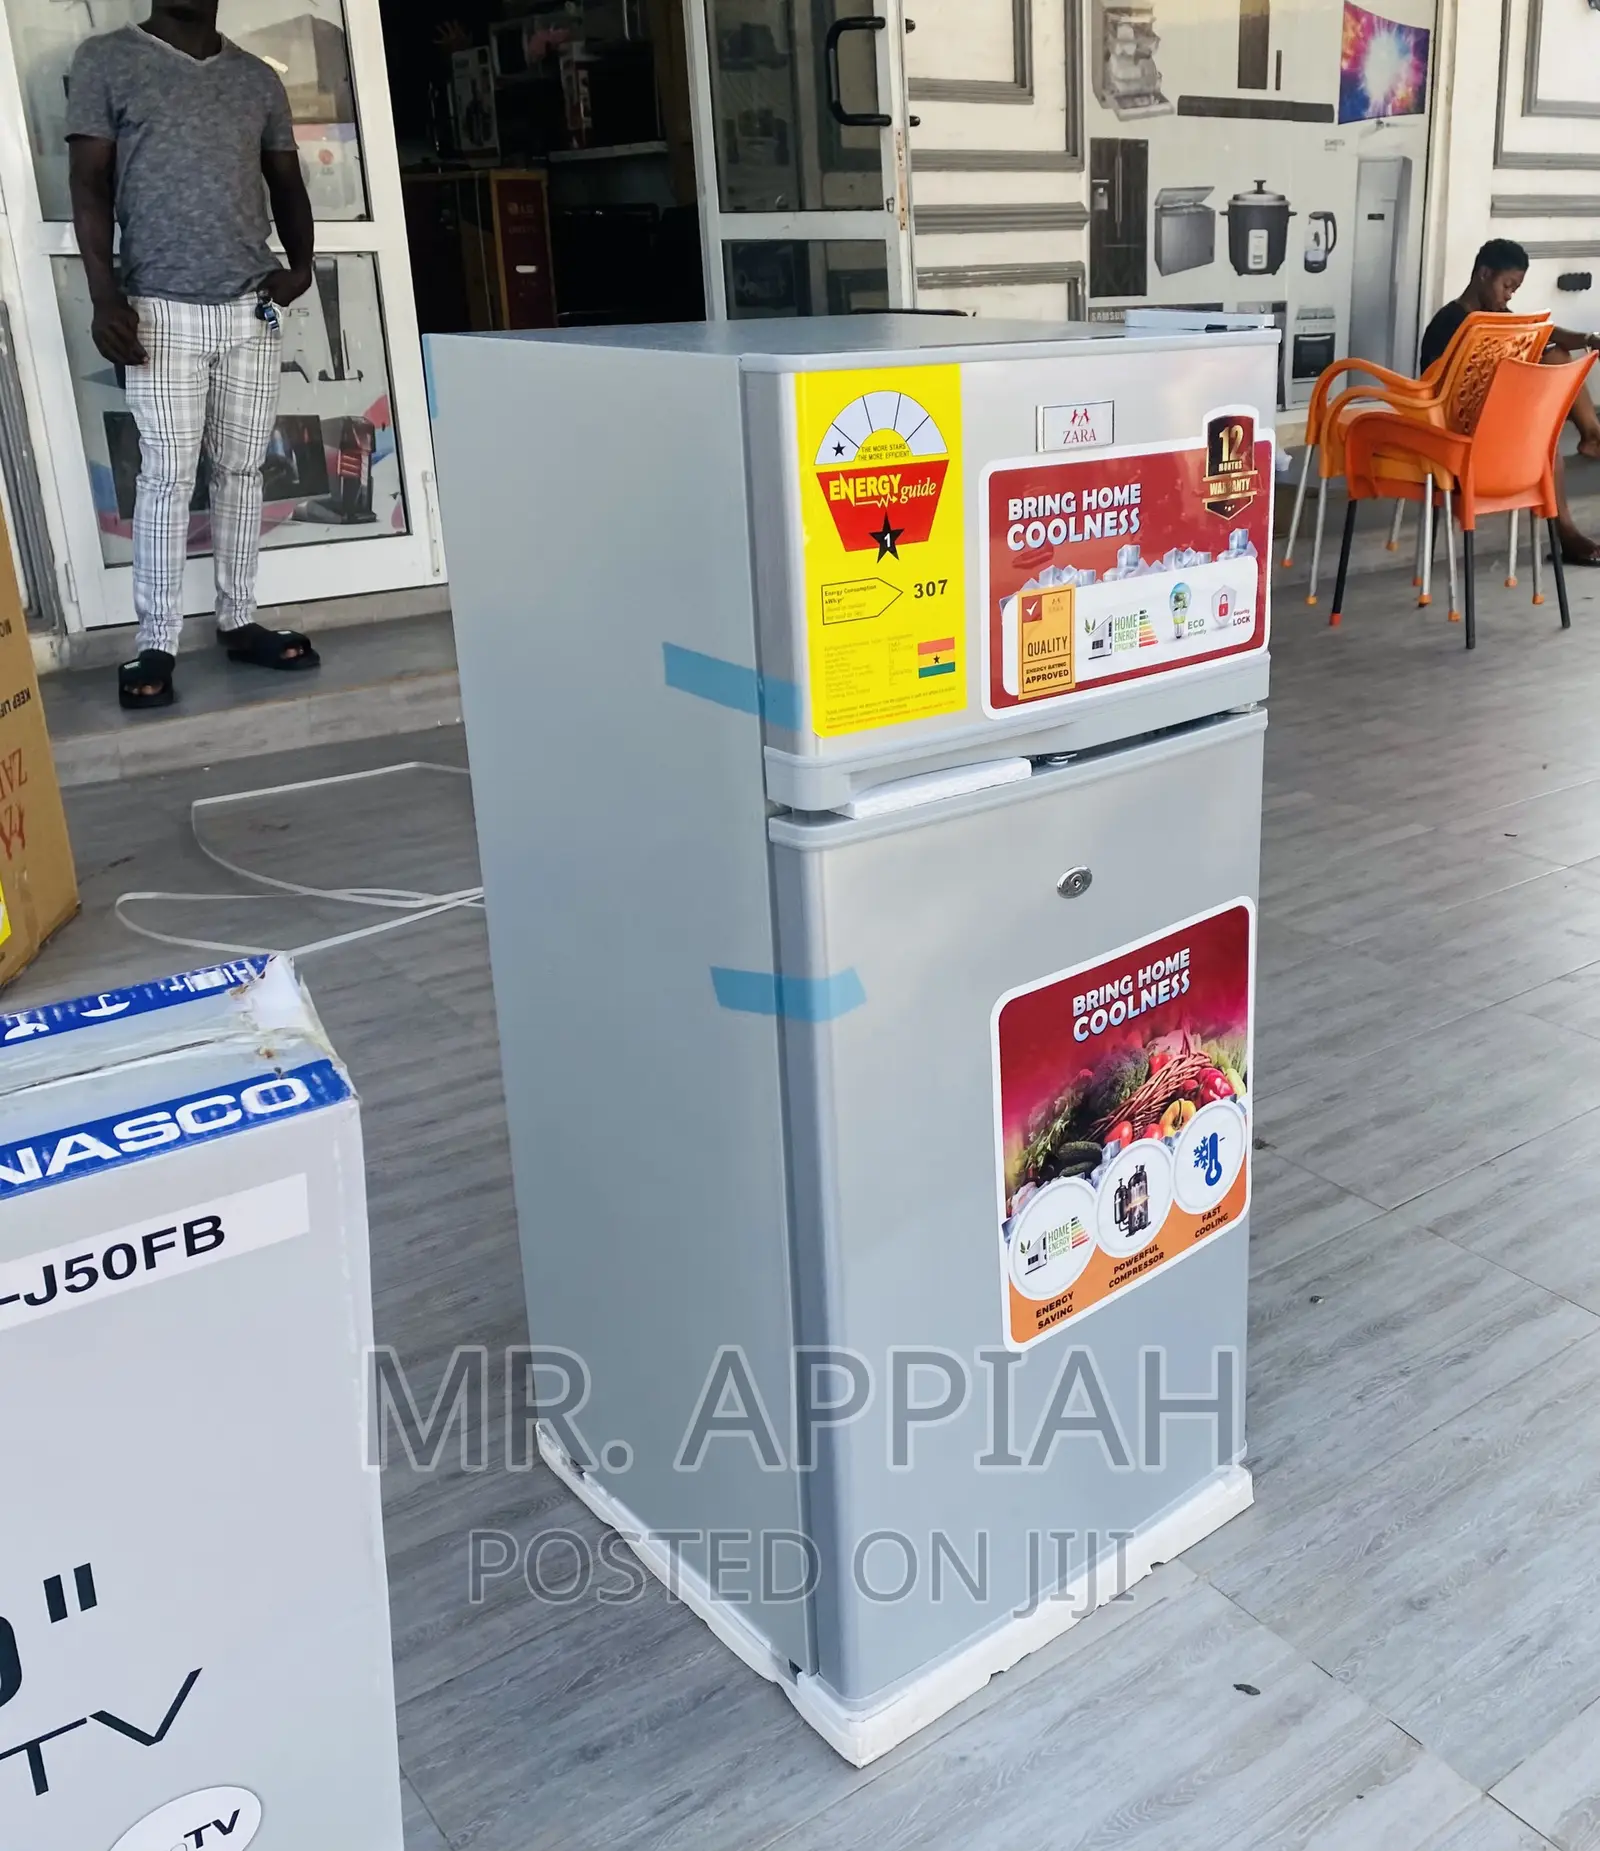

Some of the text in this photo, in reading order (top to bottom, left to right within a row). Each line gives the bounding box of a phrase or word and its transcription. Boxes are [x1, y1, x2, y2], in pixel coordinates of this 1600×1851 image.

[1091, 310, 1126, 322] SAMSUN
[1063, 428, 1097, 444] ZARA
[1219, 425, 1247, 462] 12
[868, 453, 883, 461] MORE
[885, 450, 910, 459] EFFICIENT
[873, 445, 888, 453] MORE
[889, 443, 906, 451] STARS
[829, 473, 937, 506] ENERGY guide
[1209, 478, 1251, 496] WARANTY
[1008, 483, 1142, 521] BRING HOME
[1006, 507, 1141, 552] COOLNESS
[884, 533, 891, 548] 1
[913, 579, 948, 599] 307
[1115, 614, 1138, 631] HOME
[1187, 618, 1205, 630] ECO
[1233, 615, 1251, 627] LOCK
[1114, 629, 1138, 643] ENERGY
[1027, 636, 1068, 657] QUALITY
[1025, 669, 1069, 684] APPROVED
[1026, 661, 1067, 675] ENERGY RATING
[1072, 948, 1191, 1018] BRING HOME
[1073, 969, 1191, 1043] COOLNESS
[1201, 1206, 1222, 1223] FAST
[1048, 1222, 1070, 1242] HOME
[1194, 1213, 1229, 1238] COOLING
[1048, 1236, 1070, 1252] ENERGY
[1113, 1244, 1159, 1275] POWERFUL
[1108, 1252, 1165, 1288] COMPRESSOR
[1036, 1291, 1074, 1319] ENERGY
[1037, 1304, 1074, 1330] SAVING
[184, 1809, 240, 1849] TV
